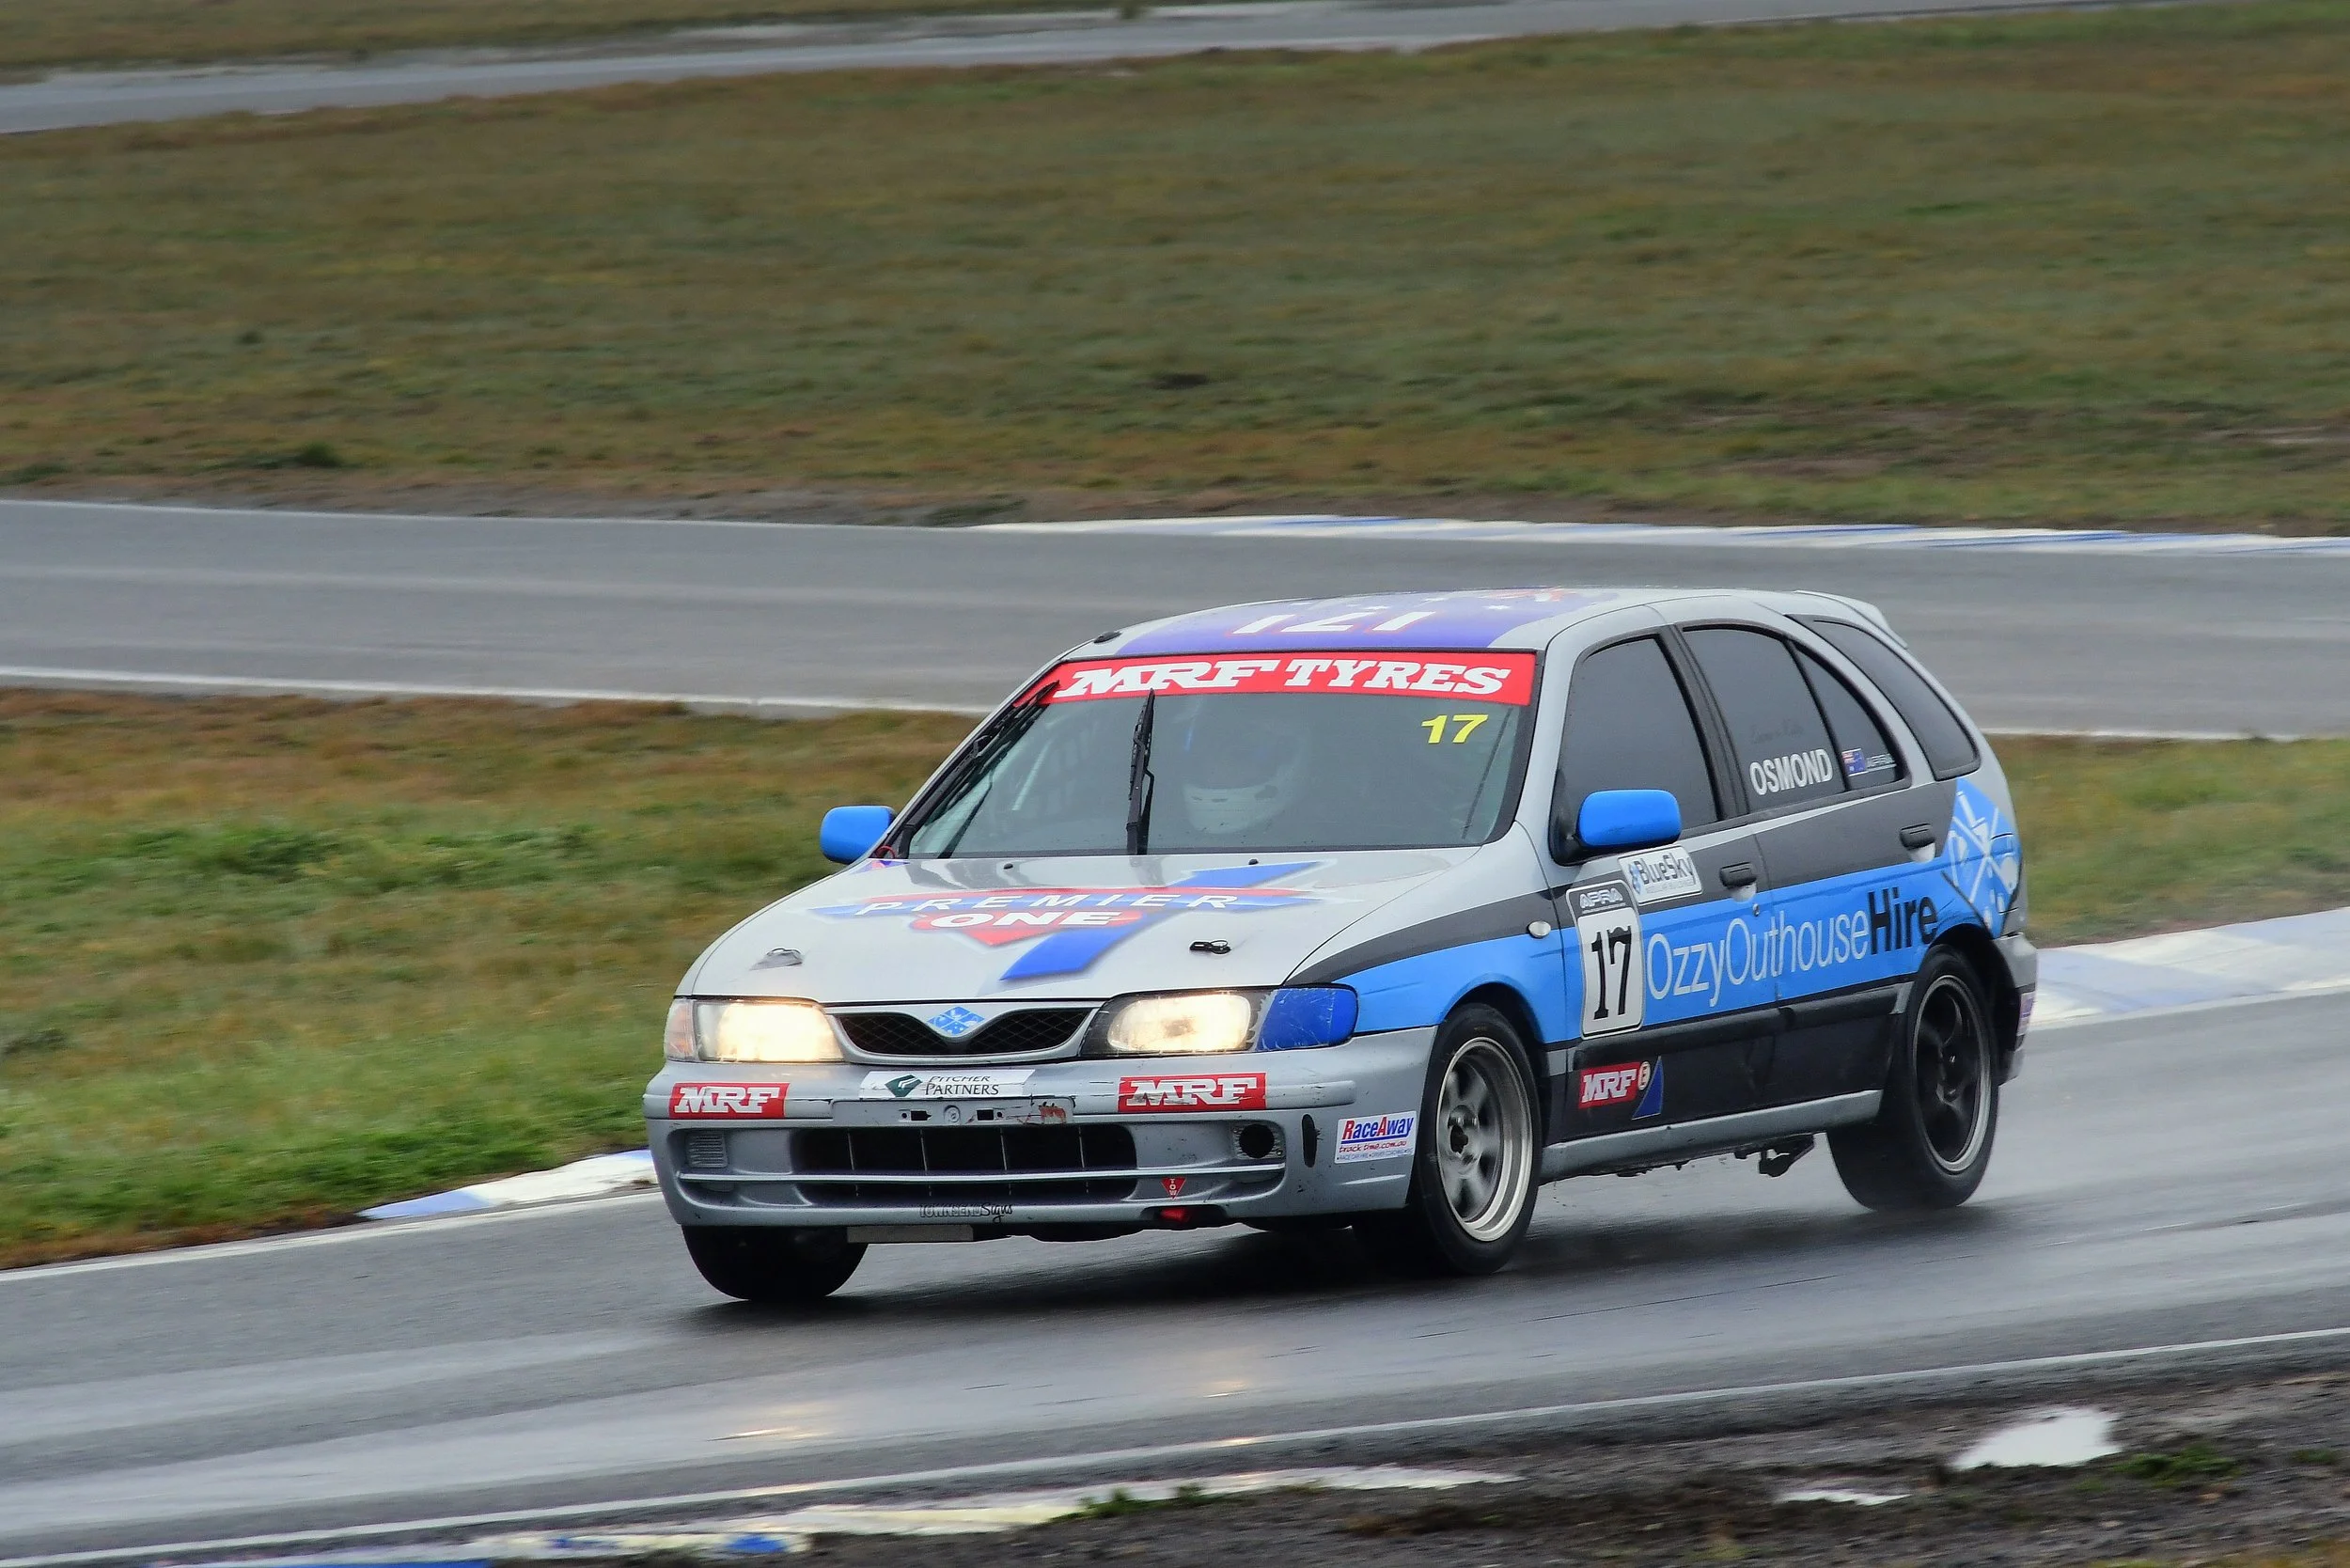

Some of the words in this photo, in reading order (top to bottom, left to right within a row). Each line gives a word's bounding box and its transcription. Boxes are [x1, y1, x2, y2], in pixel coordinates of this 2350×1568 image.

[1055, 658, 1281, 698] MRF
[1279, 660, 1512, 695] TYRES
[1421, 713, 1489, 745] 17
[1749, 748, 1833, 795] OSMOND
[854, 892, 1240, 917] PREMIER
[929, 911, 1130, 929] ONE
[1647, 888, 1938, 1007] OzzyOuthouseHire
[1591, 924, 1634, 1021] 17
[673, 1086, 781, 1115] MRF
[925, 1082, 999, 1096] PARTNERS
[1126, 1076, 1258, 1107] MRF
[1582, 1068, 1637, 1104] MRF
[1341, 1116, 1415, 1140] RaceAway
[1168, 1178, 1178, 1196] TOW
